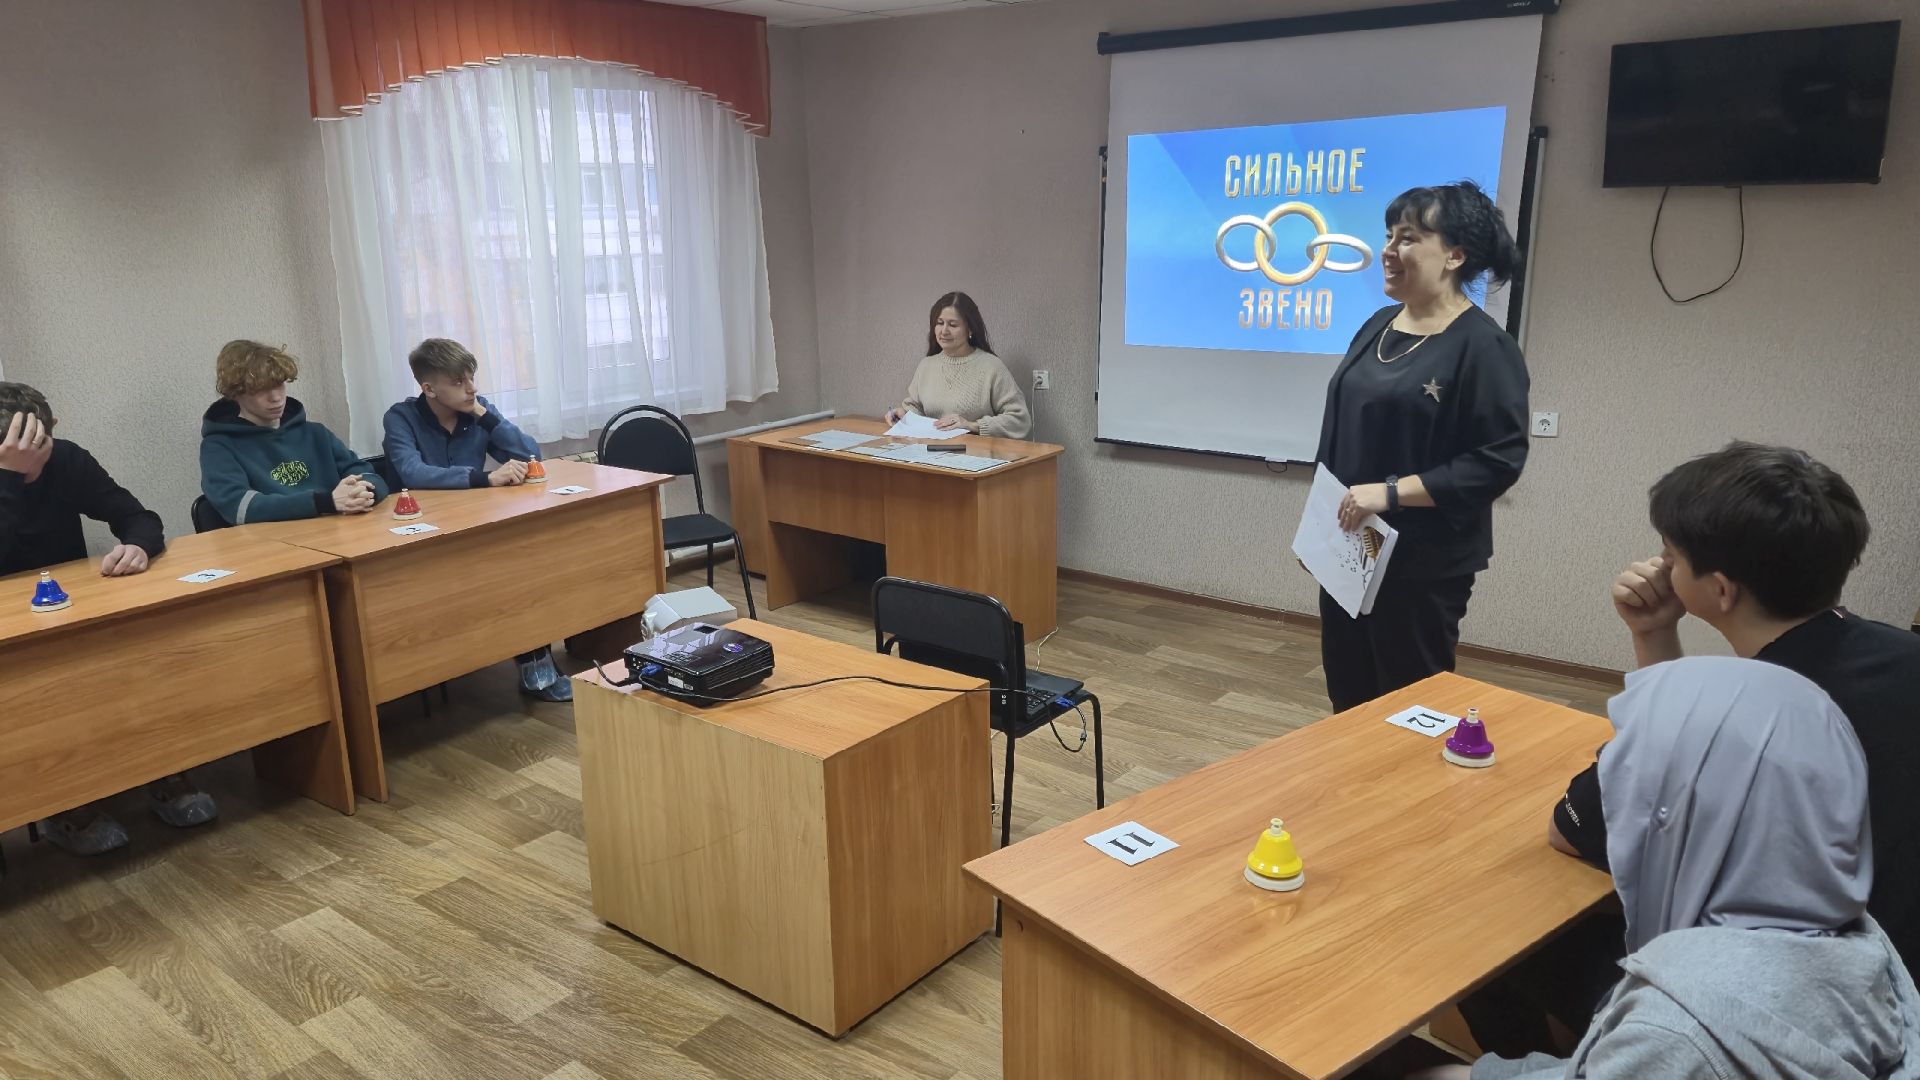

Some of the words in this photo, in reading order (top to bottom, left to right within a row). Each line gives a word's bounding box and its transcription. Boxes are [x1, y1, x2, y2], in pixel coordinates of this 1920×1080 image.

[1225, 147, 1366, 198] СИЛЬНОЕ
[1239, 287, 1333, 330] ЗВЕНО
[1406, 712, 1446, 728] 12
[1105, 831, 1156, 855] 11
